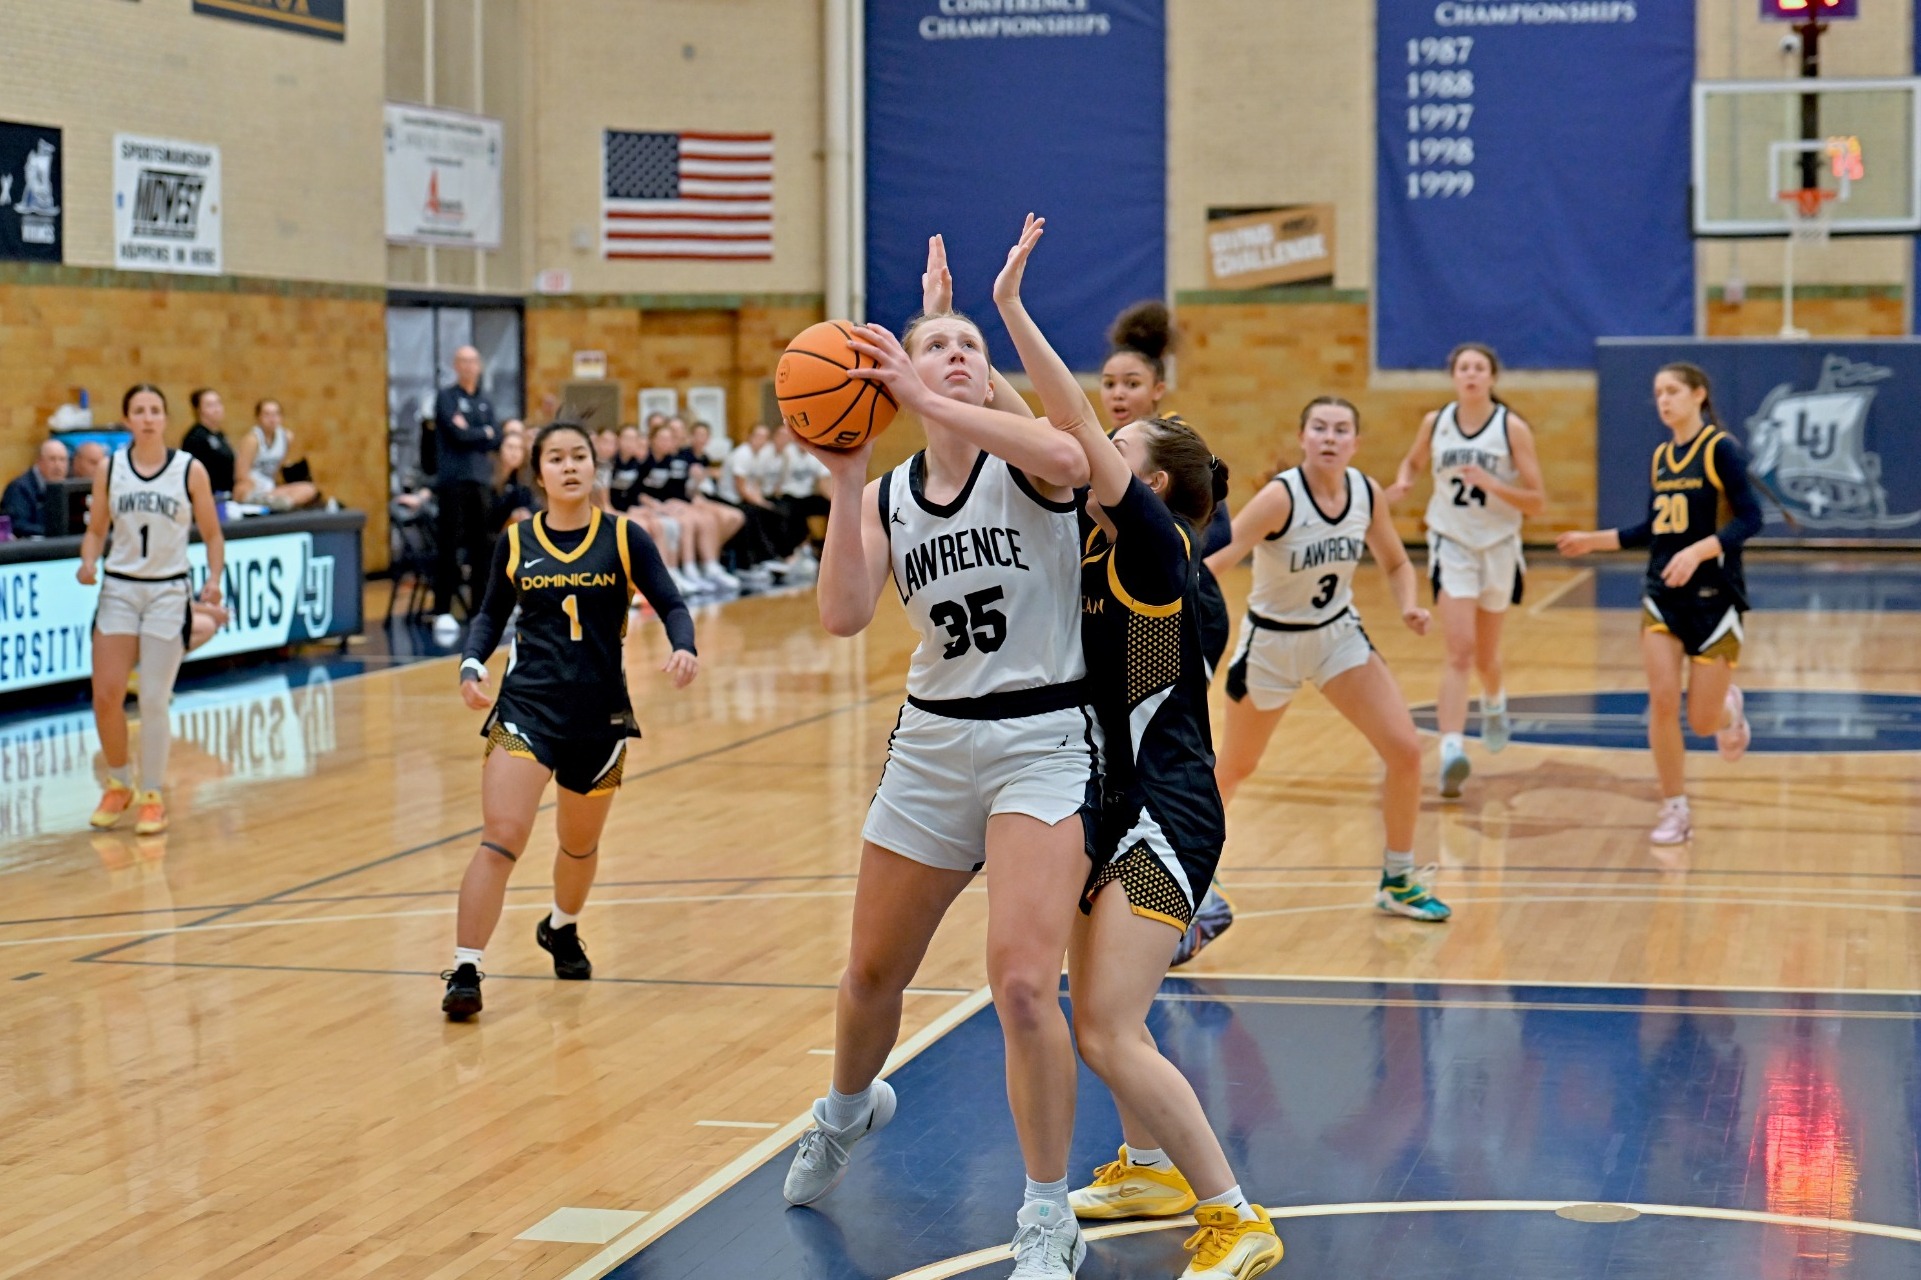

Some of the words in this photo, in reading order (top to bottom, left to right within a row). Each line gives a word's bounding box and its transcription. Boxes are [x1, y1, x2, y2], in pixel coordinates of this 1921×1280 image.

[1407, 36, 1475, 67] 1987
[1407, 69, 1475, 100] 1988
[1407, 103, 1475, 134] 1997
[1407, 136, 1475, 167] 1998
[1407, 169, 1475, 200] 1999
[1651, 493, 1689, 535] 20
[140, 524, 149, 558] 1
[521, 573, 616, 591] DOMINICAN
[1311, 573, 1338, 609] 3
[561, 594, 583, 641] 1
[929, 585, 1007, 660] 35
[0, 624, 86, 681] ERSITY
